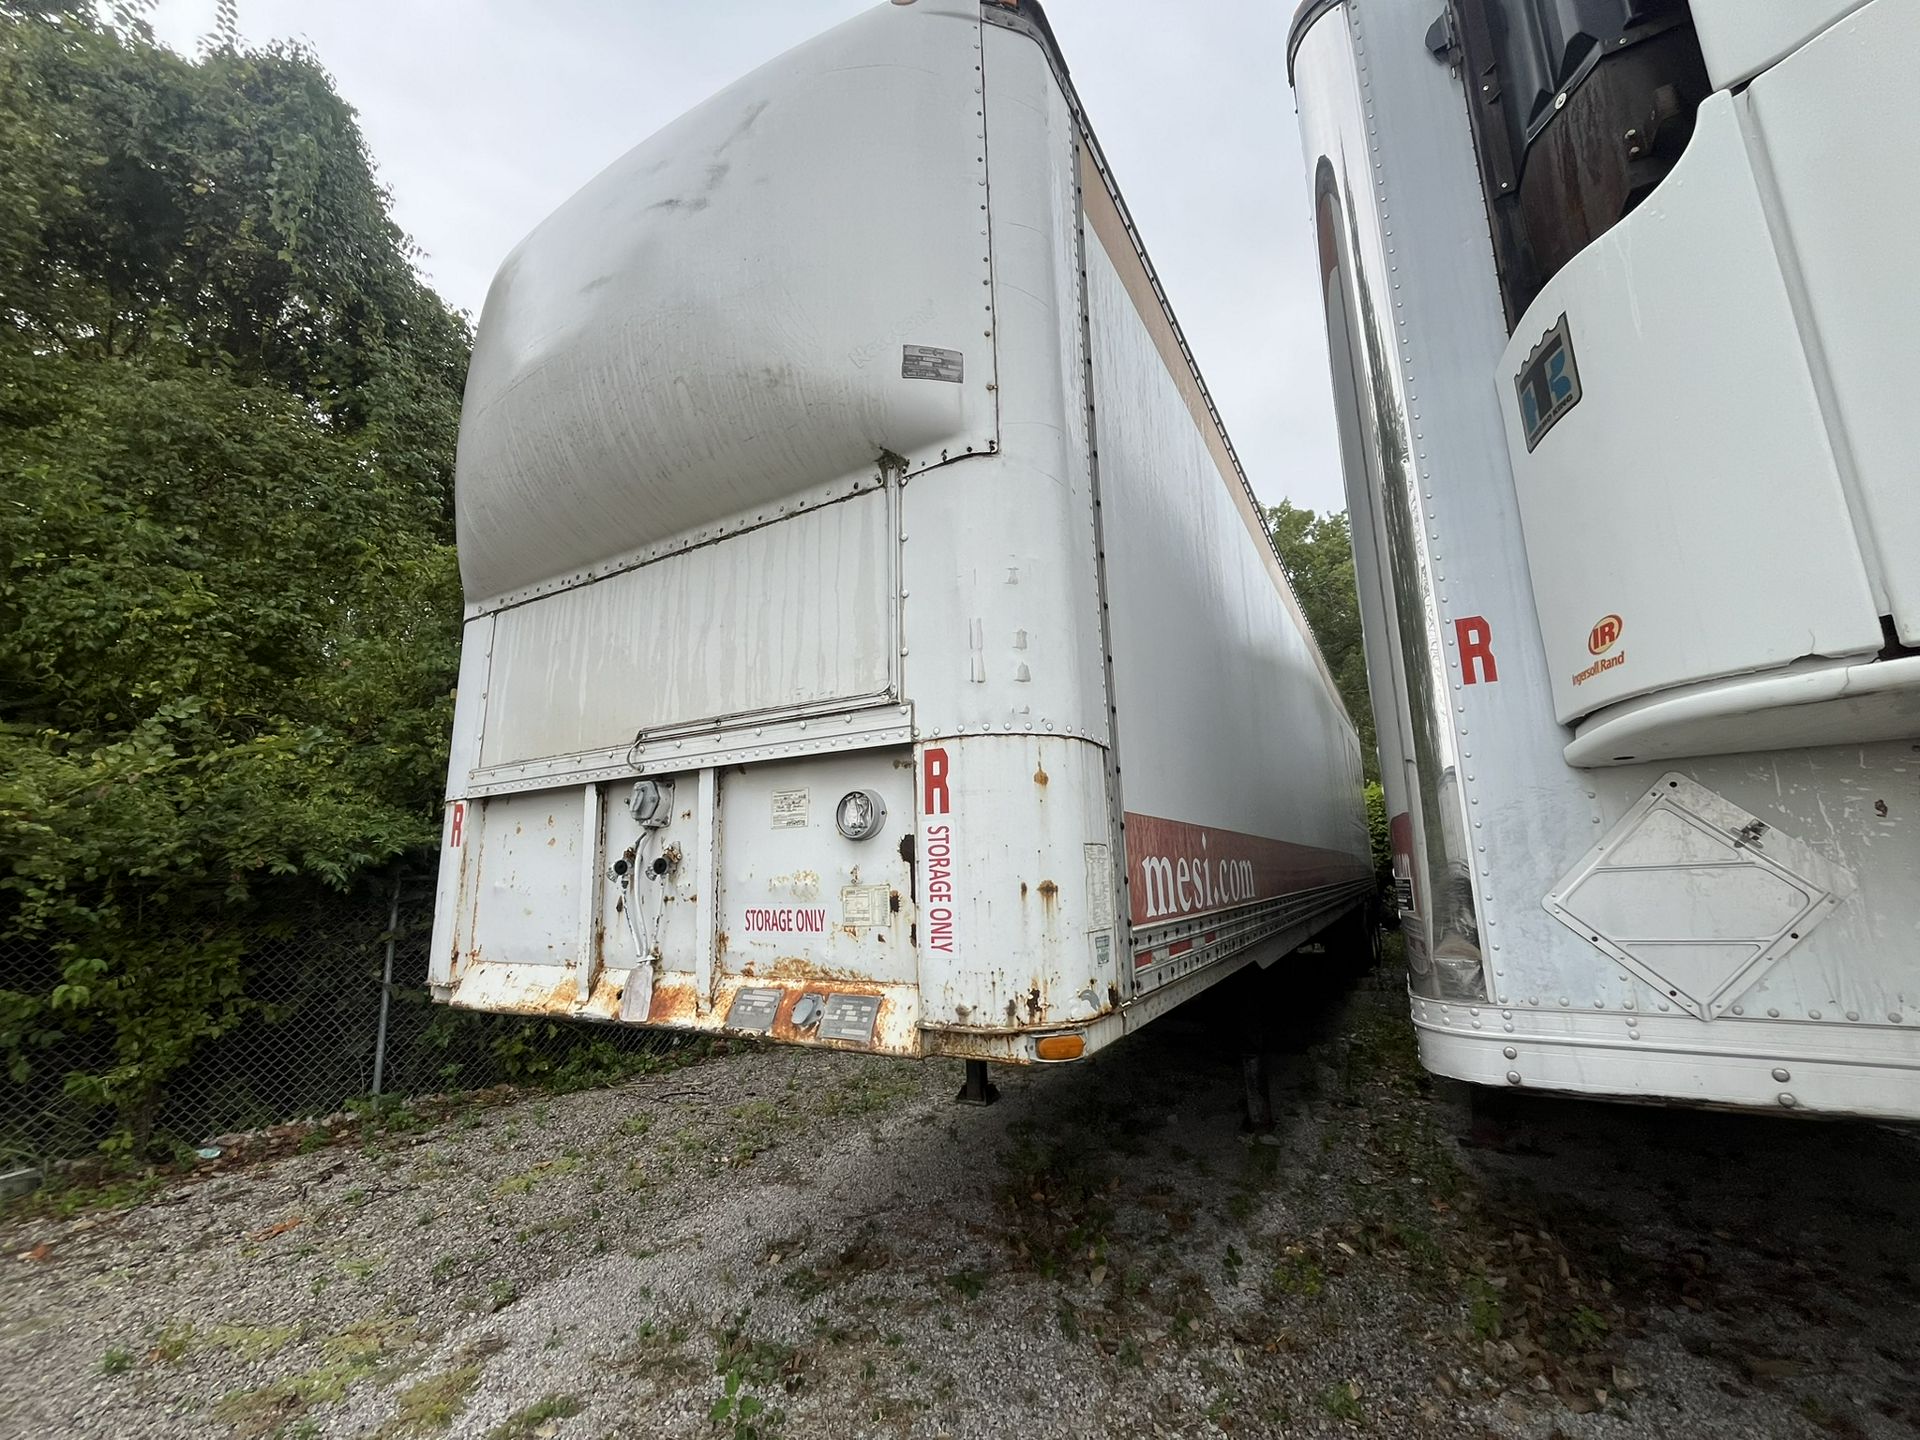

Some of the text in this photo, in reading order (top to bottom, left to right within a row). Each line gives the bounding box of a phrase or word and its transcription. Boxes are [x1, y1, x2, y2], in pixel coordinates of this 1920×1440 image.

[1529, 413, 1552, 444] TMO
[1455, 615, 1498, 685] R
[1593, 621, 1616, 650] IR
[1572, 651, 1624, 686] Ingersoll Rand
[924, 748, 950, 815] R
[450, 803, 464, 847] R
[927, 826, 953, 953] STORAGE ONLY
[1142, 832, 1255, 918] mesi.com
[745, 909, 825, 932] STORAGE ONLY
